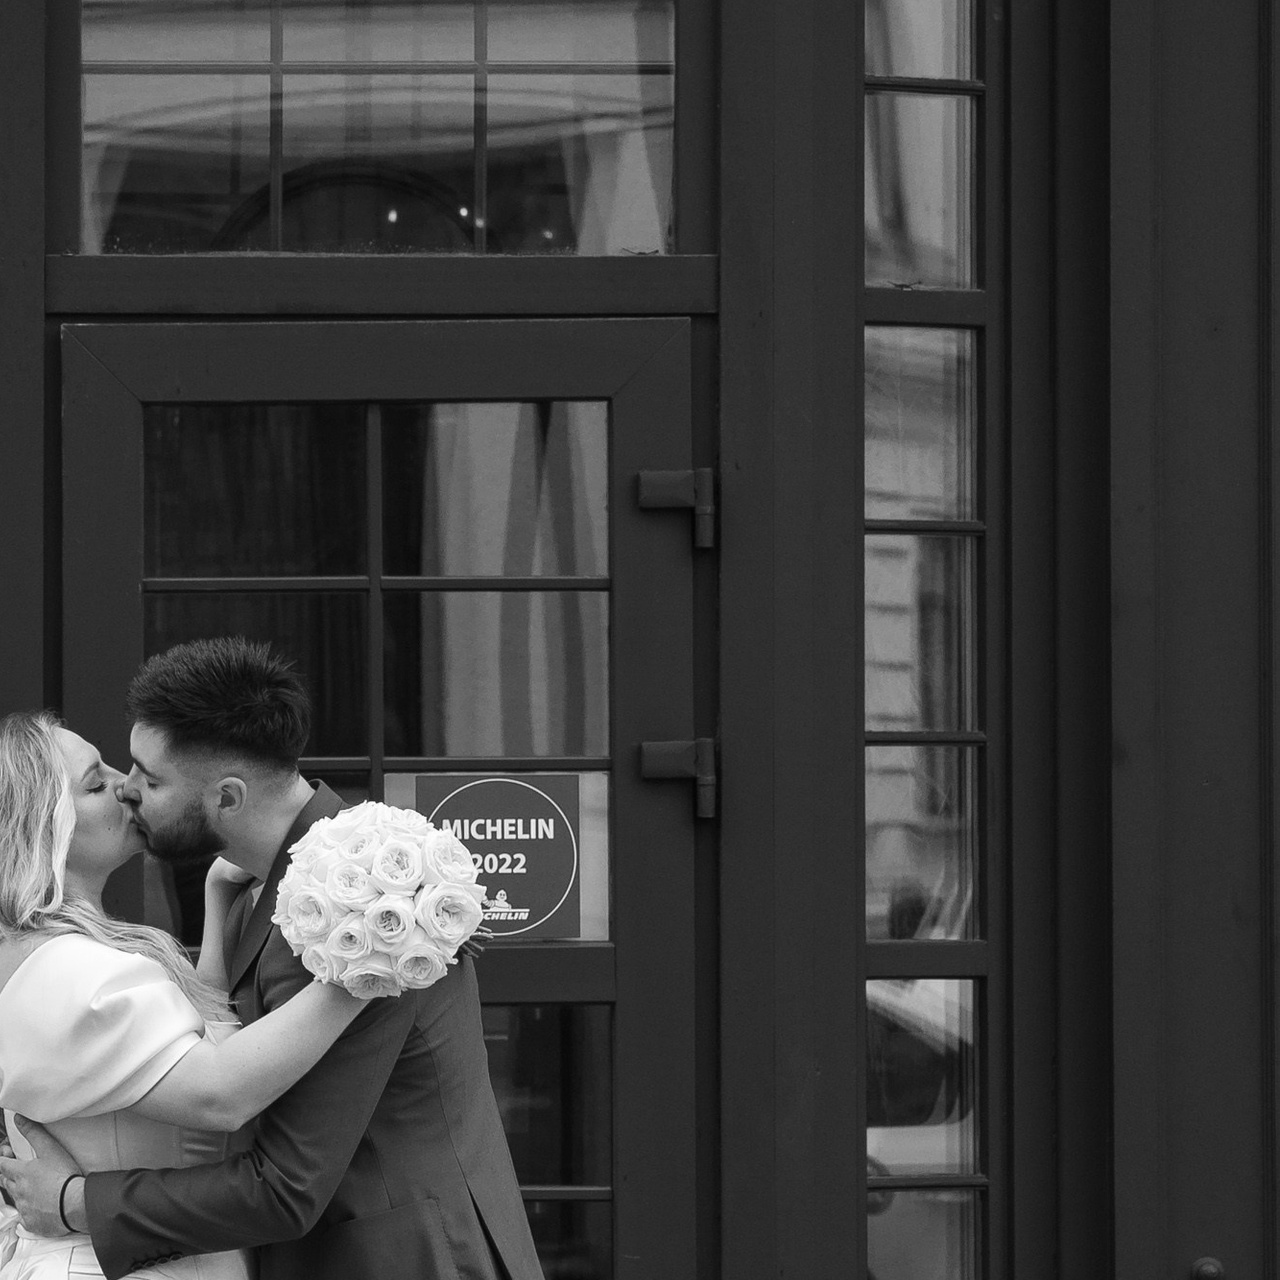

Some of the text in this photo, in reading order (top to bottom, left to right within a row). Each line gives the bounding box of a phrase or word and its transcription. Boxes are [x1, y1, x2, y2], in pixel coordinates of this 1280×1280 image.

[442, 818, 555, 840] MICHELIN
[471, 852, 528, 875] 2022
[483, 912, 529, 921] CHELIN
